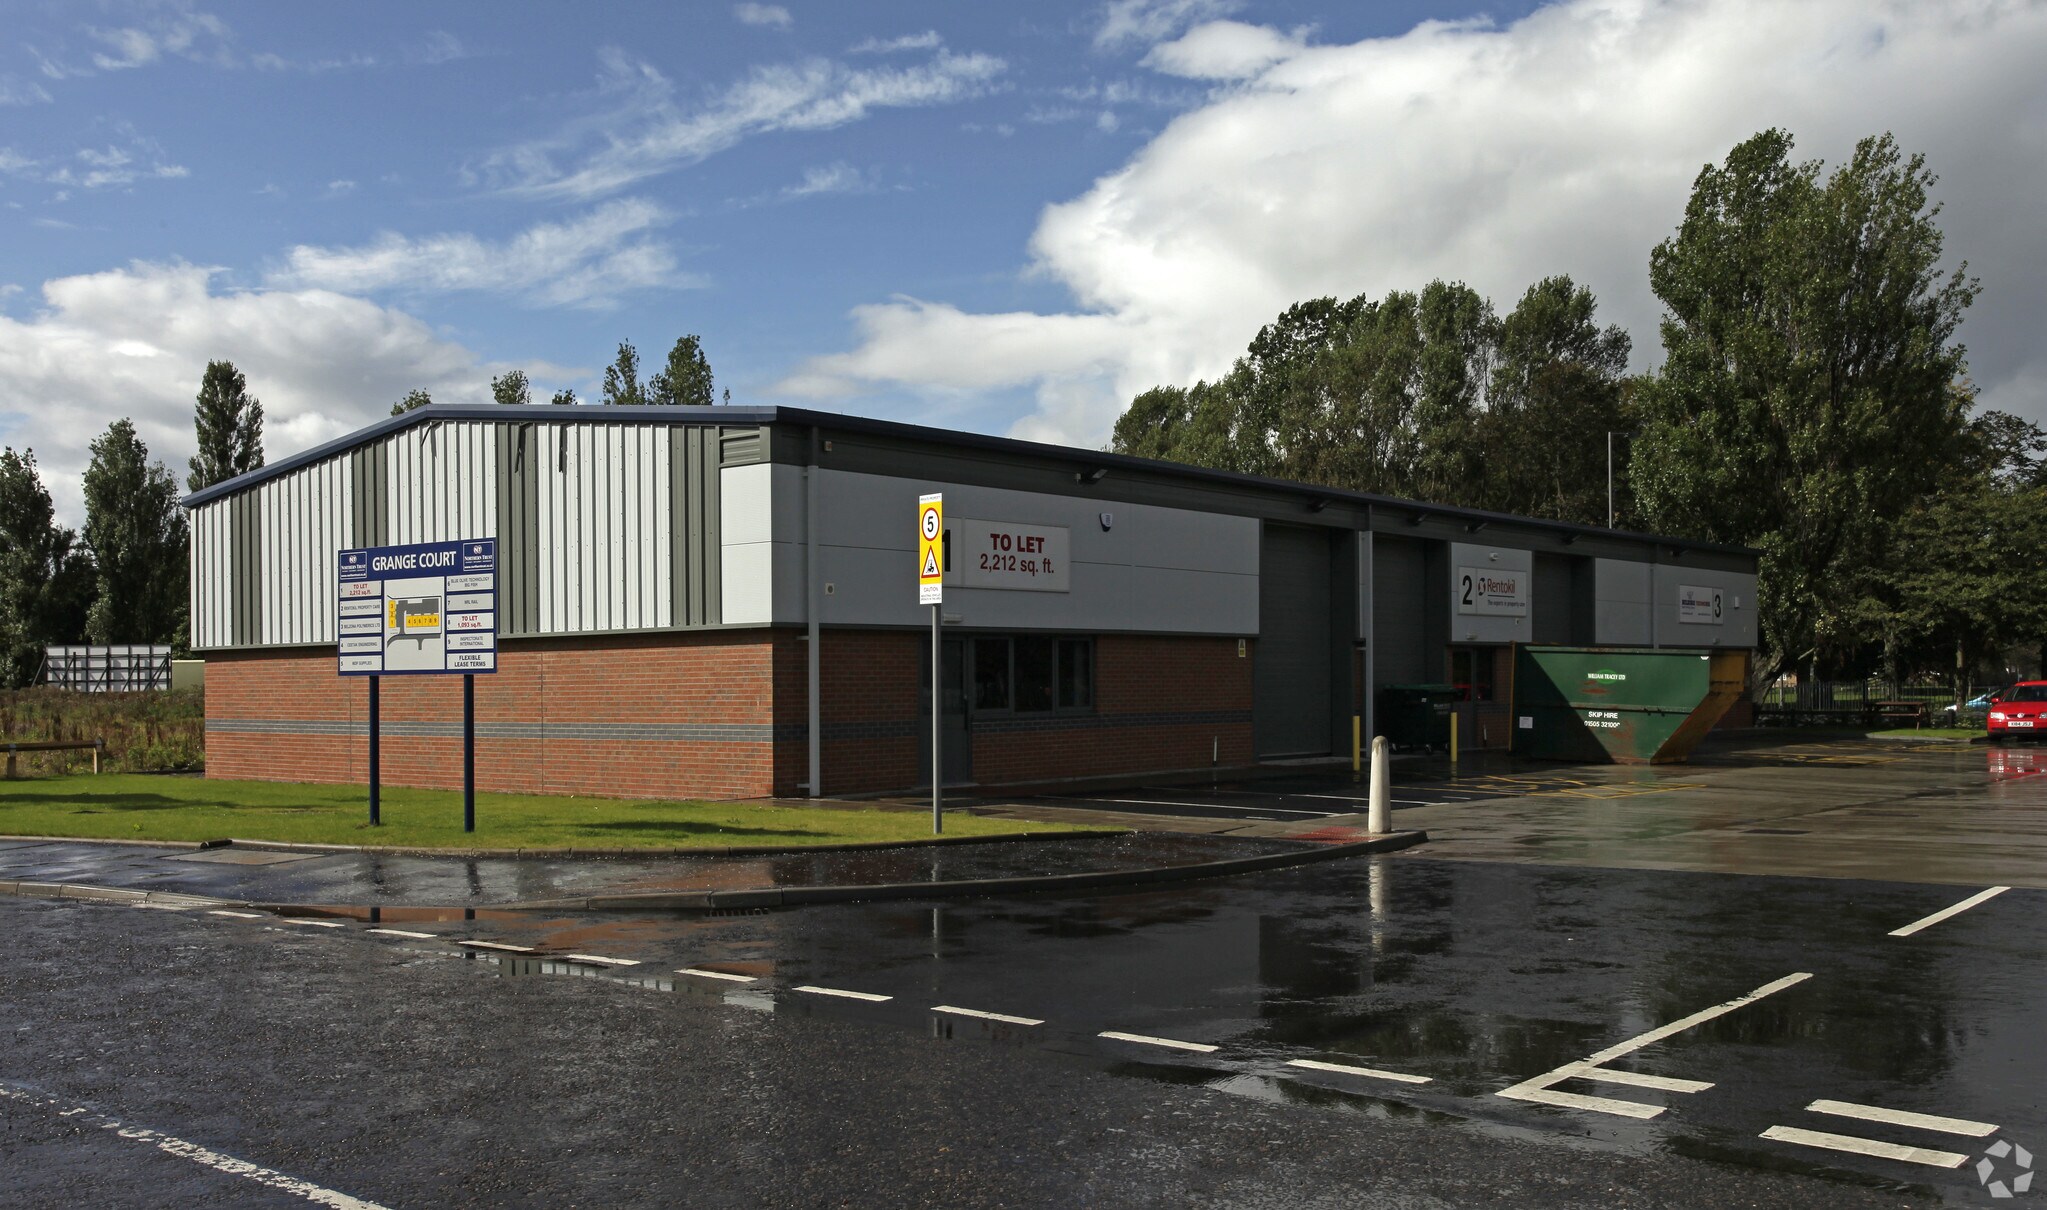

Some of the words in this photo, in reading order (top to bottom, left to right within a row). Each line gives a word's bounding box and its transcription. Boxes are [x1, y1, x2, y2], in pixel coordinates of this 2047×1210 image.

[927, 516, 934, 533] 5
[942, 529, 951, 572] 1
[990, 533, 1012, 551] TO
[1017, 535, 1045, 554] LET
[372, 554, 417, 571] GRANGE
[419, 551, 457, 568] COURT
[980, 553, 1016, 573] 2,212
[1020, 559, 1038, 577] sq.
[1043, 558, 1055, 574] ft.
[1462, 575, 1473, 605] 2
[1487, 578, 1515, 594] Rentokil
[1714, 594, 1721, 618] 3
